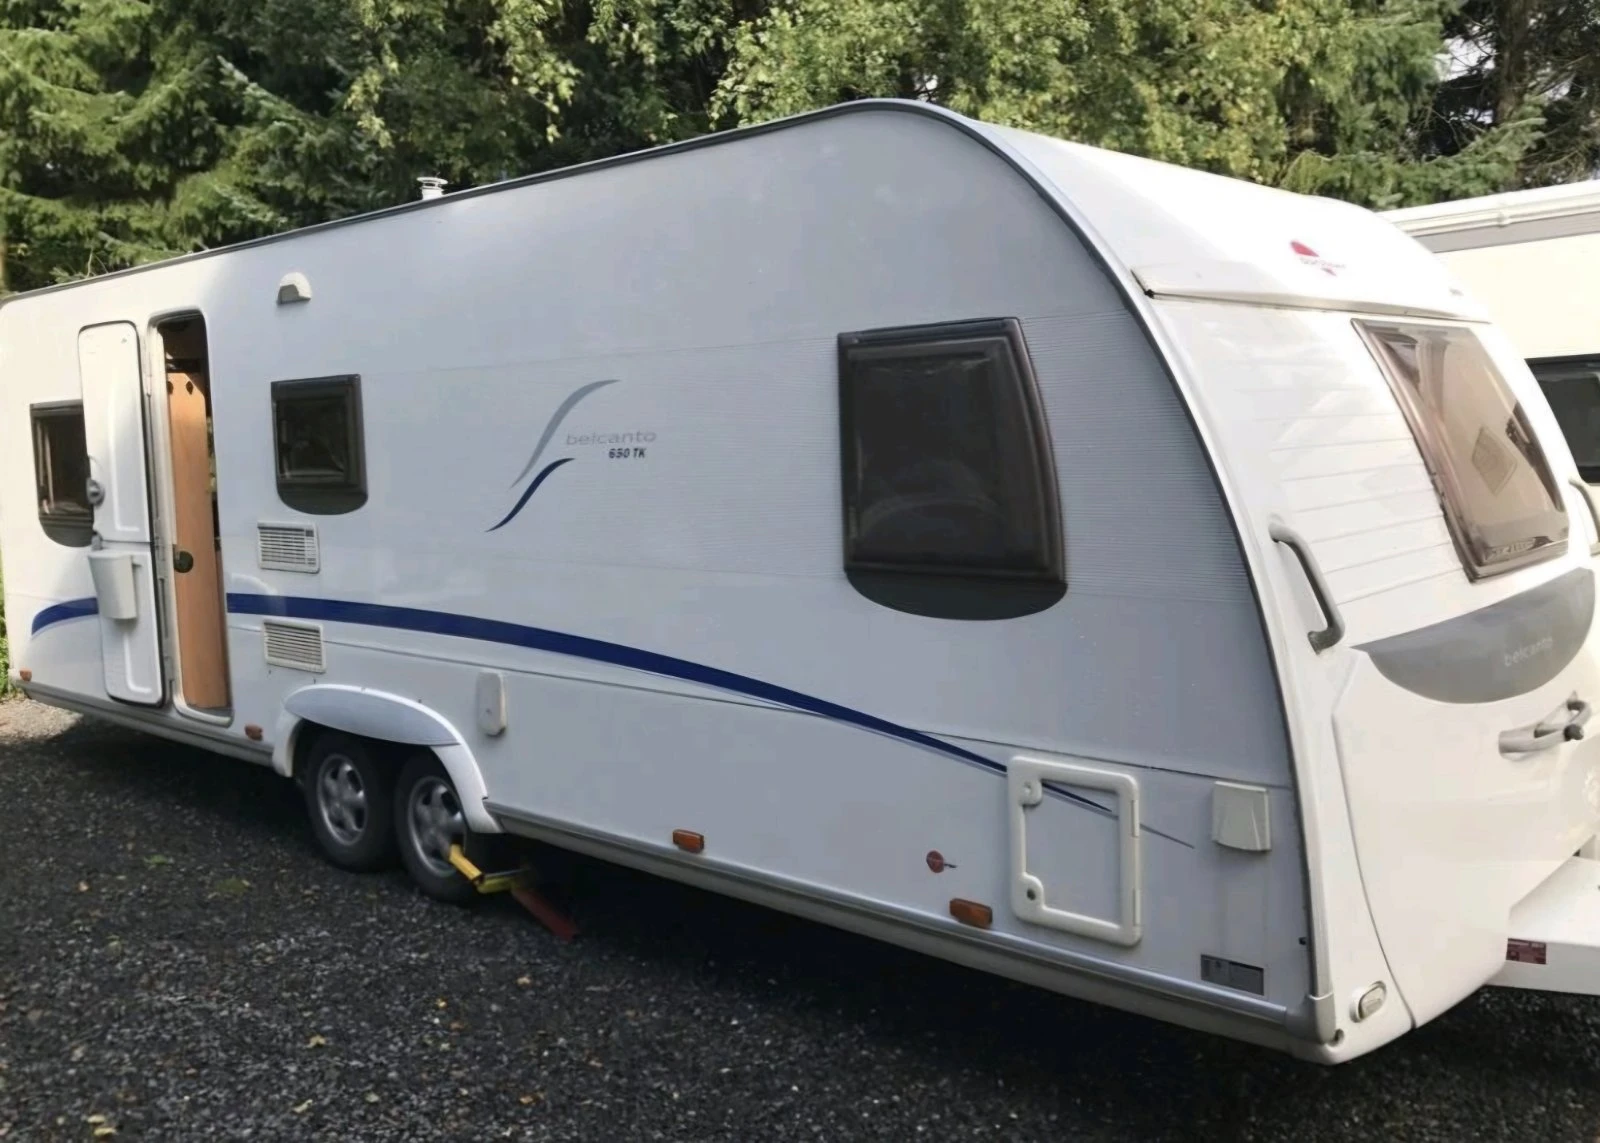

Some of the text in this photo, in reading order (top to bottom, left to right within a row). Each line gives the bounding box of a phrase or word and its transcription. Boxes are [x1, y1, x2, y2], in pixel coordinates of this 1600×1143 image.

[566, 431, 657, 445] belcanto
[608, 447, 647, 459] 650 TK
